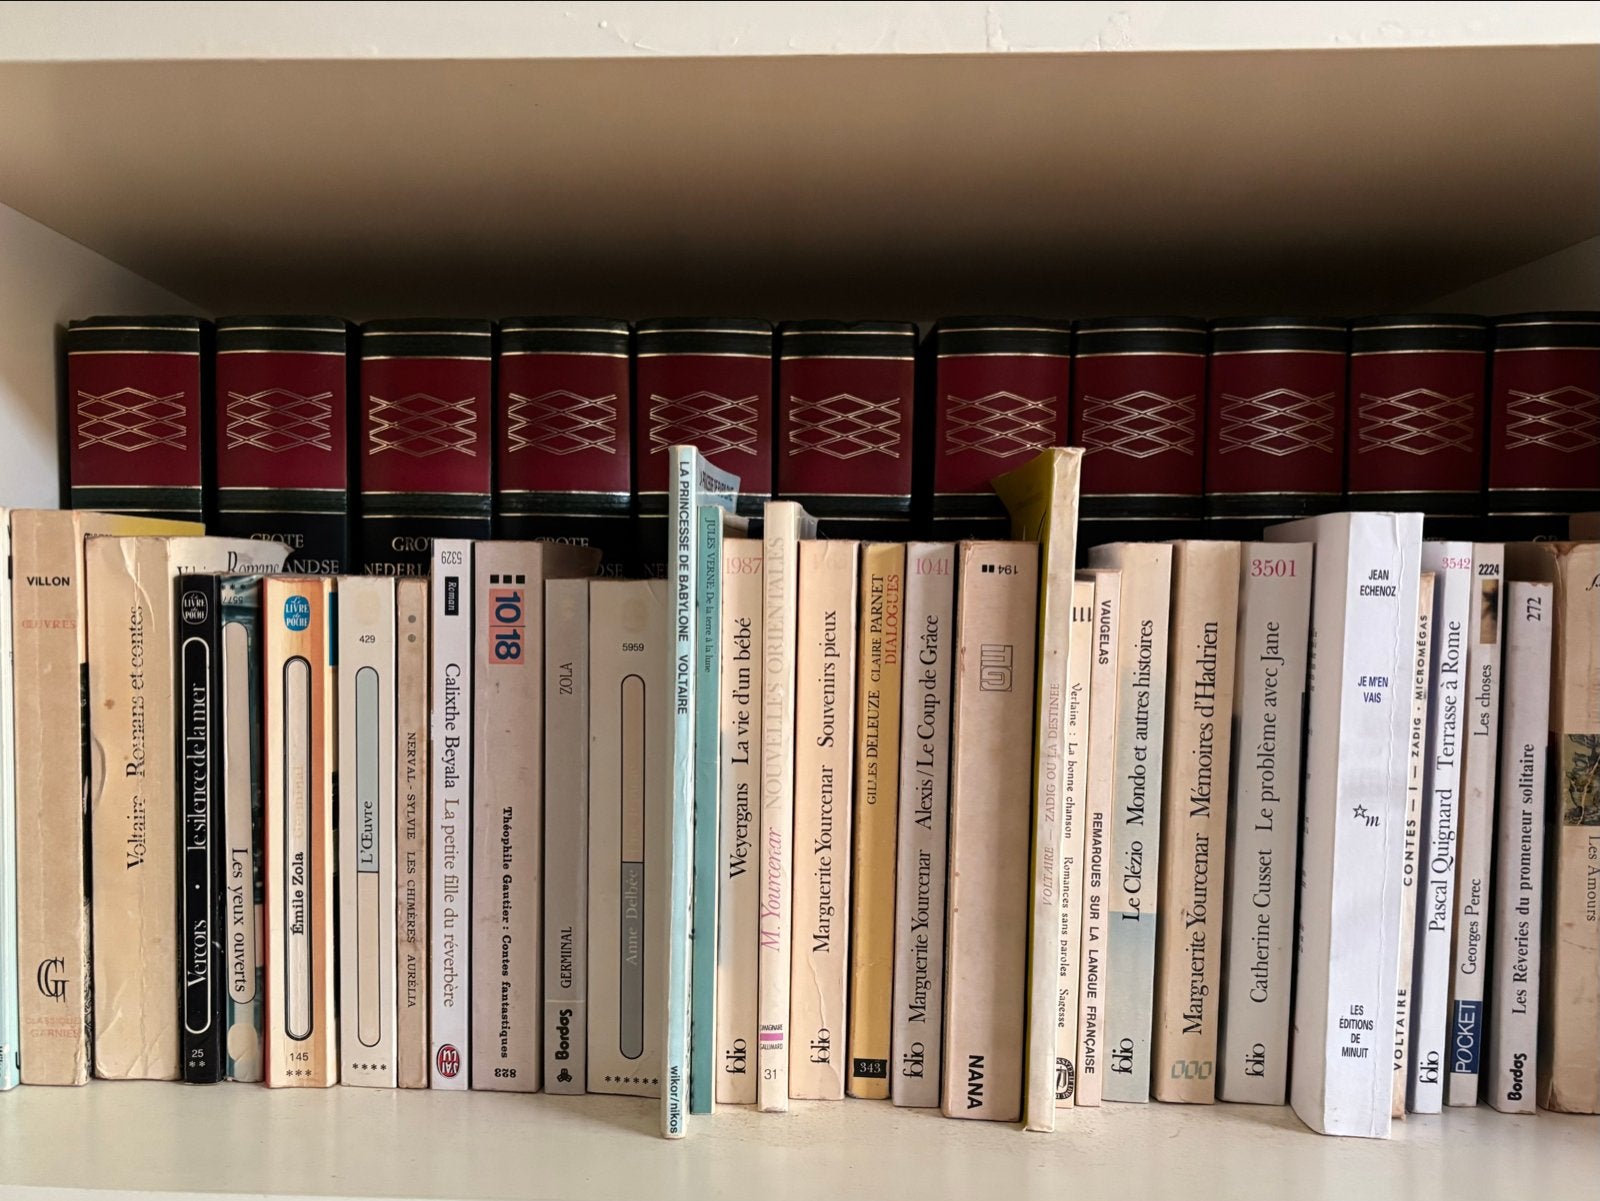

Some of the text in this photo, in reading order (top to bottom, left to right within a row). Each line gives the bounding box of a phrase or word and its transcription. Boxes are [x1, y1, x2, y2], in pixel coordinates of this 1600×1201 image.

[441, 550, 462, 565] 5329
[678, 461, 689, 642] LA PRINCESSE DE BABYLONE
[726, 556, 763, 575] 1987
[916, 558, 950, 576] 1041
[998, 564, 1018, 575] 194
[1251, 559, 1297, 577] 3501
[1442, 557, 1471, 570] 3542
[1478, 563, 1500, 576] 2224
[27, 577, 70, 586] VILLON
[448, 582, 458, 611] Roman
[704, 518, 715, 673] JULES lune
[1359, 585, 1397, 597] ECHENOZ
[1368, 569, 1389, 581] JEAN
[184, 599, 206, 607] LIVRE
[285, 603, 309, 613] LIVRE
[495, 591, 521, 624] 10
[884, 574, 899, 665] DIALOGUES
[1527, 596, 1542, 622] 272
[359, 634, 376, 644] 429
[495, 629, 521, 662] 18
[622, 643, 645, 652] 5959
[1098, 600, 1112, 665] VAUGELAS
[560, 662, 573, 695] ZOLA
[677, 654, 689, 715] VOLTAIRE
[866, 573, 884, 758] DELEUZE CLAIRE PARNET
[1357, 676, 1368, 687] JE
[1363, 692, 1382, 704] VAIS
[1474, 664, 1492, 737] Les choses
[125, 606, 147, 869] Voltaire Romans contes
[729, 617, 753, 880] Weyergans La vie d'un bébé
[761, 537, 785, 918] Yourcenar NOUVELLES ORIENTALES
[187, 683, 206, 851] le silence de mer
[1122, 619, 1153, 922] Le Clézio Mondo et autres histoires
[1403, 614, 1429, 887] CONTES ZADIG MICROMÉGAS
[812, 610, 840, 953] Marguerite Yourcenar Souvenirs pieux
[1428, 621, 1461, 933] Pascal Quignard Terrasse Rome
[907, 615, 941, 1024] Marguerite Yourcenar Coup de Grâce
[1043, 744, 1057, 906] VOLTAIRE ZADIG OU LA
[1061, 682, 1083, 935] Verlaine La bonne chanson Romances sans
[1183, 621, 1219, 1035] Marguerite Yourcenar Mémoires d'Hadrien
[1249, 621, 1286, 1004] Catherine Cusset Le problème avec Jane
[441, 663, 461, 1009] Calixthe Beyala La petite fille du réverbère
[406, 732, 418, 1009] NERVAL SYLVIE LES CHIMÈRES AURÉLIA
[1512, 744, 1535, 1015] Les Rêveries du promeneur solitaire
[290, 852, 305, 937] Émile Zola
[624, 869, 639, 920] Delbée
[228, 849, 248, 994] Les yeux ouverts
[499, 806, 514, 1059] Théophile Gautier Contes fantastiques
[1084, 812, 1103, 1074] REMARQUES SUR LA LANGUE FRANÇAISE
[1461, 879, 1482, 975] Georges Perec
[188, 921, 207, 989] Vercors
[560, 926, 573, 989] GERMINAL
[625, 927, 639, 966] Anne
[1339, 1016, 1374, 1031] ÉDITIONS
[1350, 1004, 1364, 1016] LES
[1393, 988, 1407, 1071] VOLTAIRE
[191, 1049, 204, 1058] 25
[289, 1052, 309, 1061] 145
[555, 1009, 573, 1061] Bordas
[725, 1038, 747, 1074] folio
[809, 1028, 831, 1065] folio
[1111, 1037, 1134, 1075] folio
[1341, 1046, 1369, 1058] MINUIT
[1350, 1033, 1361, 1044] DE
[1455, 1000, 1476, 1073] POCKET
[494, 1067, 517, 1078] 823
[764, 1068, 777, 1080] 31
[859, 1061, 881, 1073] 343
[902, 1042, 925, 1079] folio
[1244, 1043, 1266, 1079] folio
[1419, 1050, 1440, 1084] folio
[1507, 1053, 1527, 1101] Bordas
[670, 1065, 681, 1134] wikor/nikos
[967, 1055, 985, 1110] NANA
